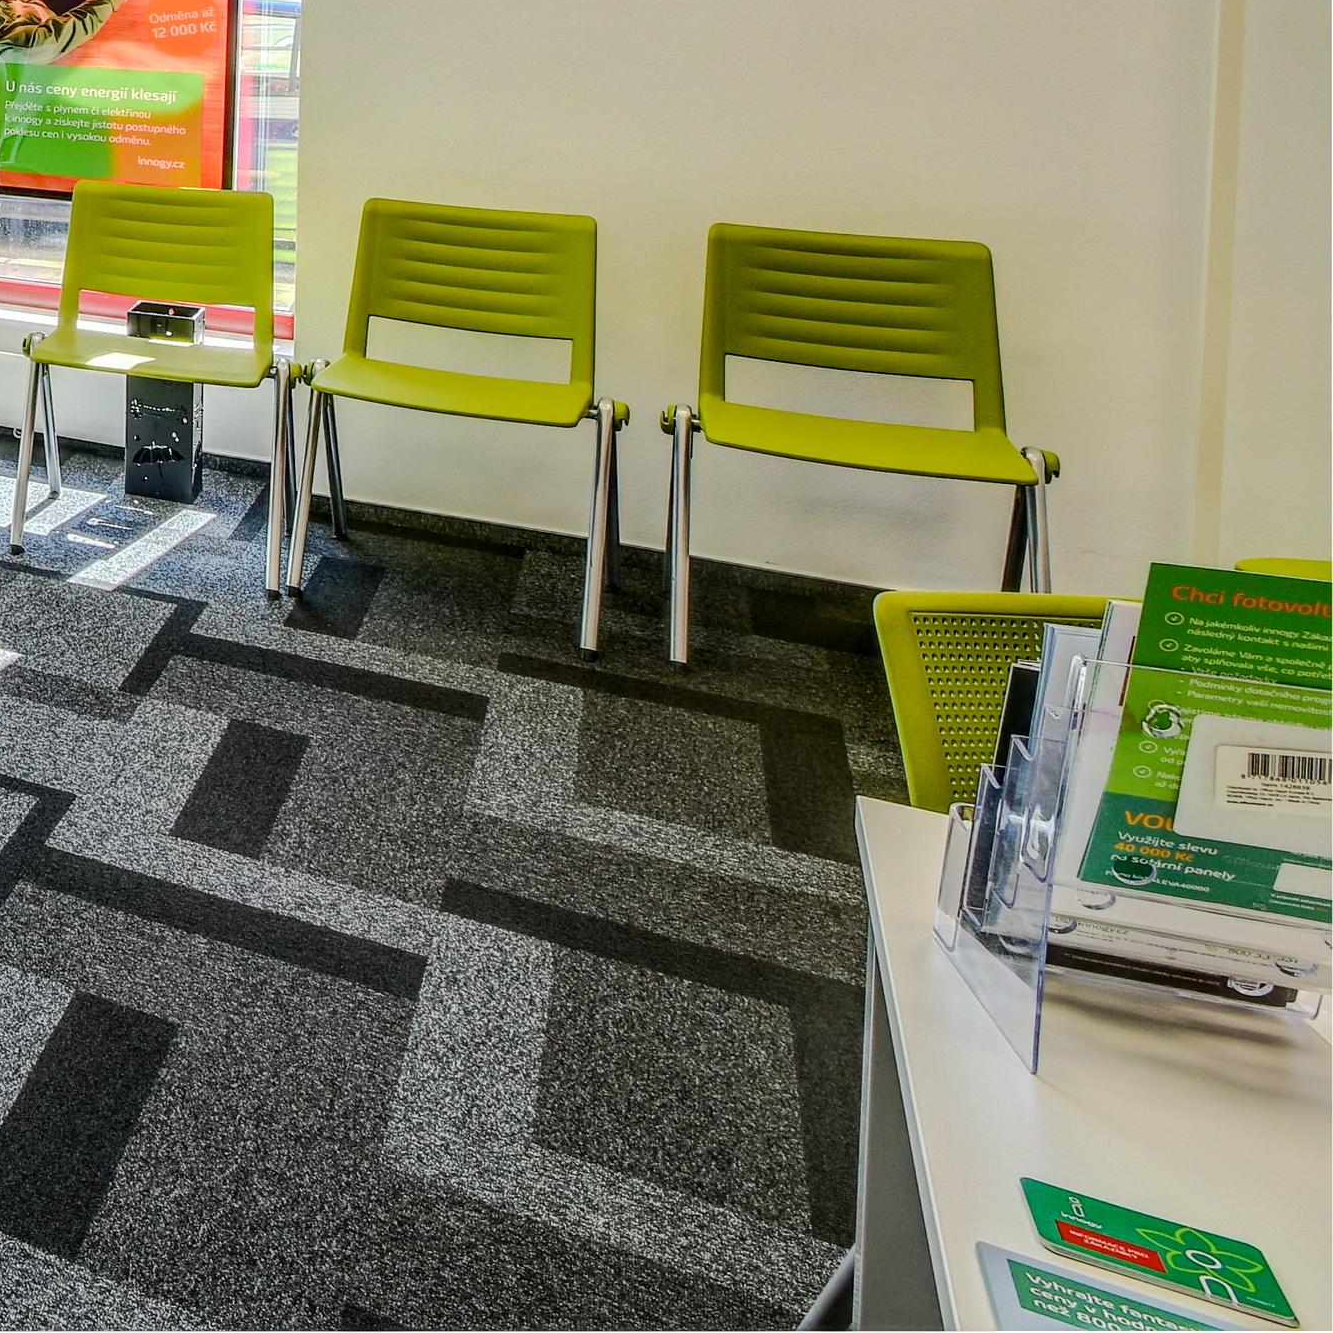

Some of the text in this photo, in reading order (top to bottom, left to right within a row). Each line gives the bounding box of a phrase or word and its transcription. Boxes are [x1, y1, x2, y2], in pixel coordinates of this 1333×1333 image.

[149, 10, 198, 24] Odměna
[152, 21, 217, 39] 12 000 Kč
[5, 80, 177, 104] U nás ceny energií klesají
[5, 100, 43, 112] Přejděte
[54, 104, 91, 116] plynem
[92, 105, 99, 116] či
[102, 108, 151, 119] elektřinou
[11, 115, 43, 126] innogy
[54, 117, 90, 129] získejte
[91, 120, 123, 131] jistotu
[125, 124, 186, 135] postupného
[5, 127, 39, 138] poklesu
[42, 130, 59, 139] cen
[67, 132, 107, 143] vysokou
[109, 135, 152, 146] odměnu.
[137, 156, 185, 169] innogy.cz
[1171, 584, 1225, 605] Chci
[1187, 628, 1235, 641] následný
[1237, 634, 1280, 646] kontakt
[1189, 617, 1204, 627] Na
[1205, 618, 1261, 632] jakémkoliv
[1263, 627, 1299, 639] innogy
[1181, 655, 1202, 665] aby
[1203, 657, 1254, 672] splňovala
[1184, 644, 1236, 658] Zavoláme
[1239, 651, 1263, 661] Vám
[1276, 657, 1325, 669] společně
[1187, 689, 1244, 705] Parametry
[1189, 678, 1242, 693] Podmínky
[1244, 685, 1301, 701] dotačního
[1115, 842, 1135, 852] 40
[1140, 845, 1171, 858] 000
[1117, 830, 1218, 856] Využijte slevu
[1184, 866, 1236, 881] panely
[1025, 1272, 1115, 1309] Vyhrajte
[1029, 1287, 1077, 1308] ceny
[1084, 1304, 1096, 1314] v
[1033, 1300, 1071, 1317] než
